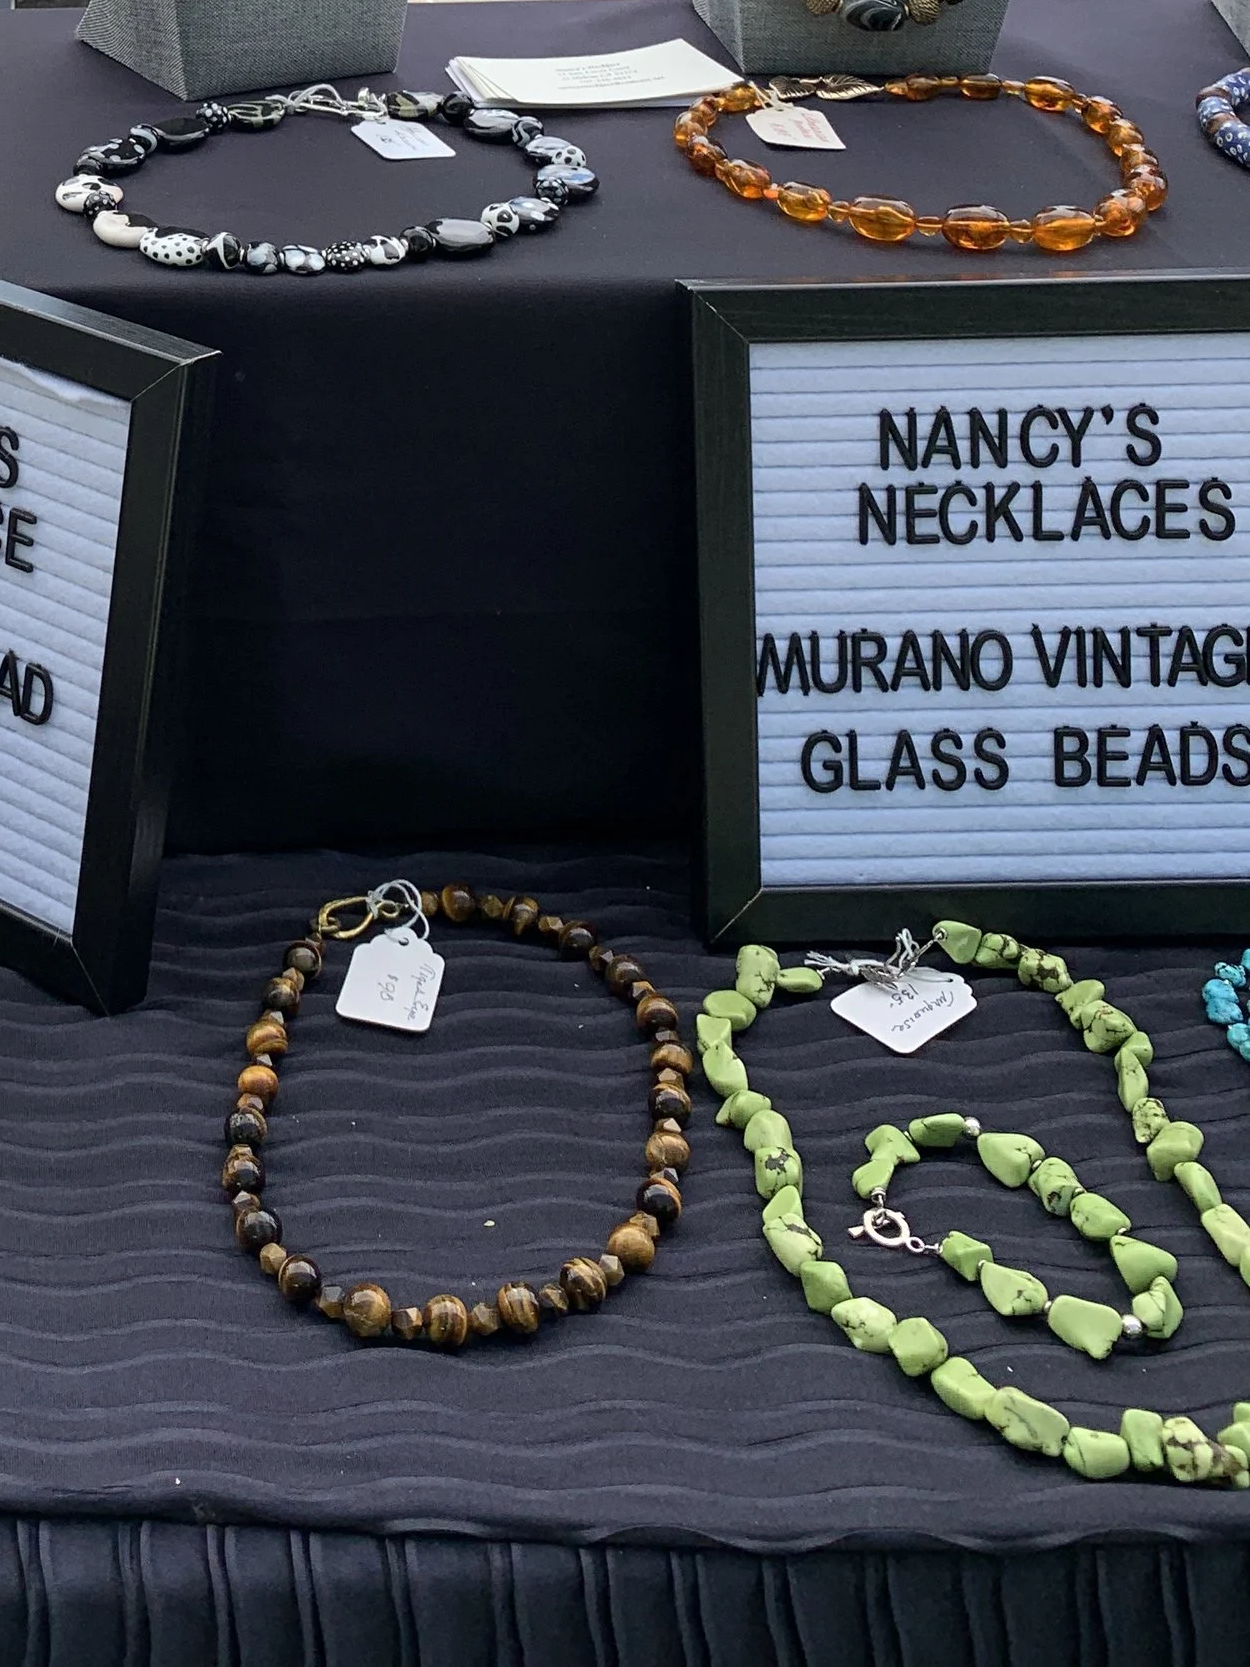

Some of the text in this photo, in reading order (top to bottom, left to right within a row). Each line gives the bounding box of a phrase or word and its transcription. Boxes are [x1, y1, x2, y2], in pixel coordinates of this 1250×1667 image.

[876, 403, 1162, 471] NANCY'S
[856, 476, 1236, 545] NECKLACES
[756, 623, 1250, 697] MURANO VINTAG
[798, 721, 1250, 794] GLASS BEADS
